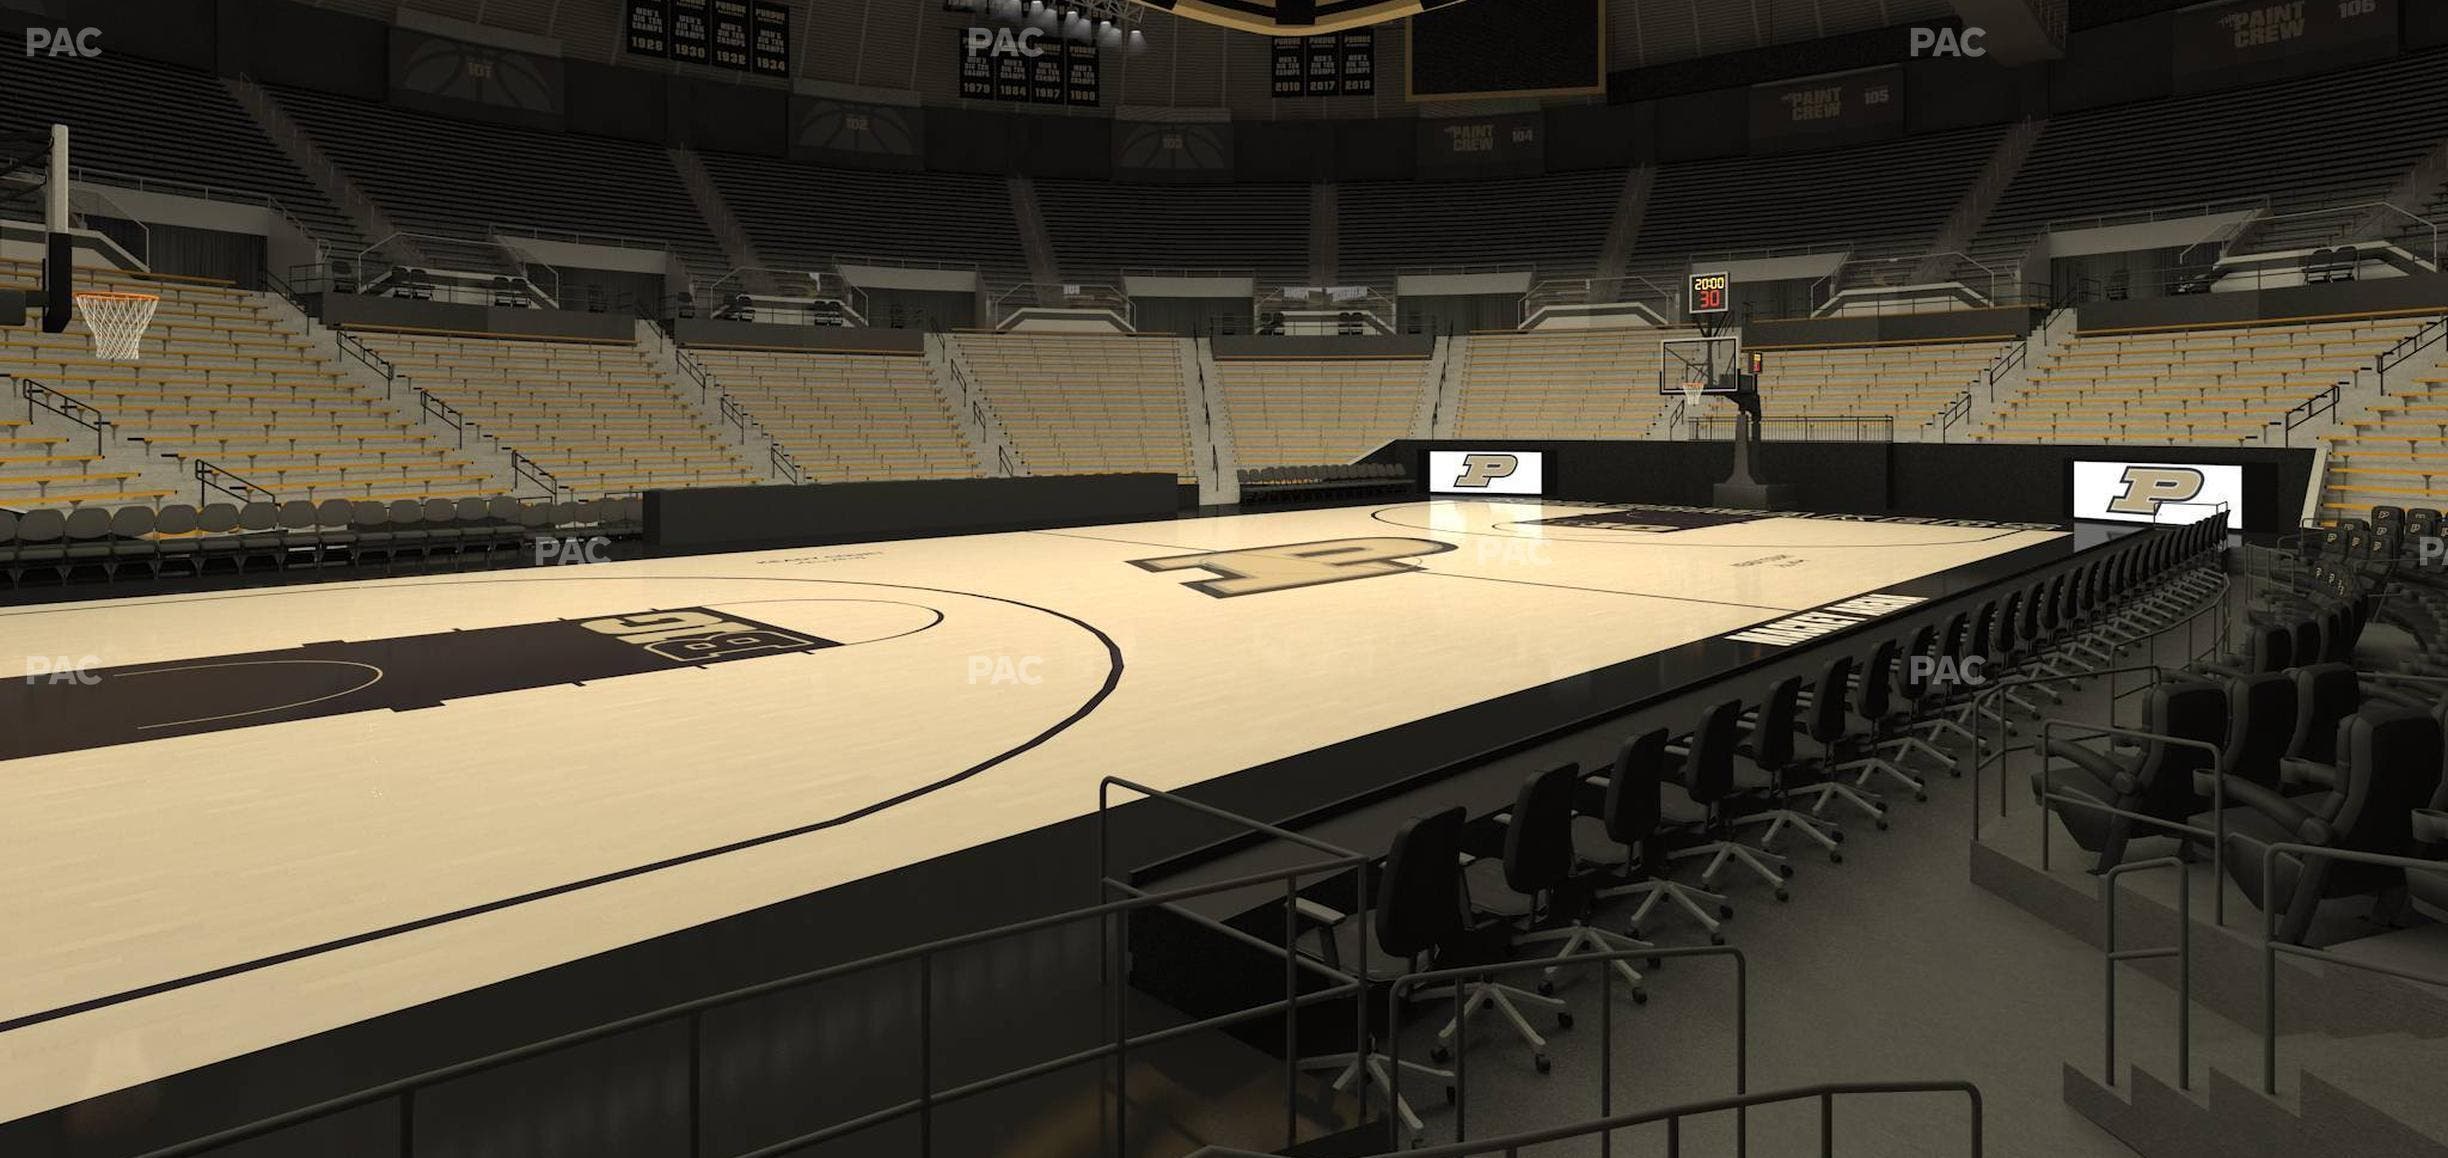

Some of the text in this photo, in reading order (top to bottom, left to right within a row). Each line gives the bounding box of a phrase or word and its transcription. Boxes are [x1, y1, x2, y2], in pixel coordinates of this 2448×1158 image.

[2234, 1, 2304, 31] PAINT
[2234, 17, 2305, 48] CREW
[1310, 80, 1336, 91] 2017
[1344, 80, 1371, 90] 2019
[1792, 86, 1842, 106] PAINT
[1864, 88, 1889, 105] 105
[1792, 102, 1841, 120] CREW
[1694, 277, 1725, 291] 20:00
[1700, 290, 1721, 308] 30
[1453, 454, 1518, 488] P
[2106, 465, 2205, 516] P
